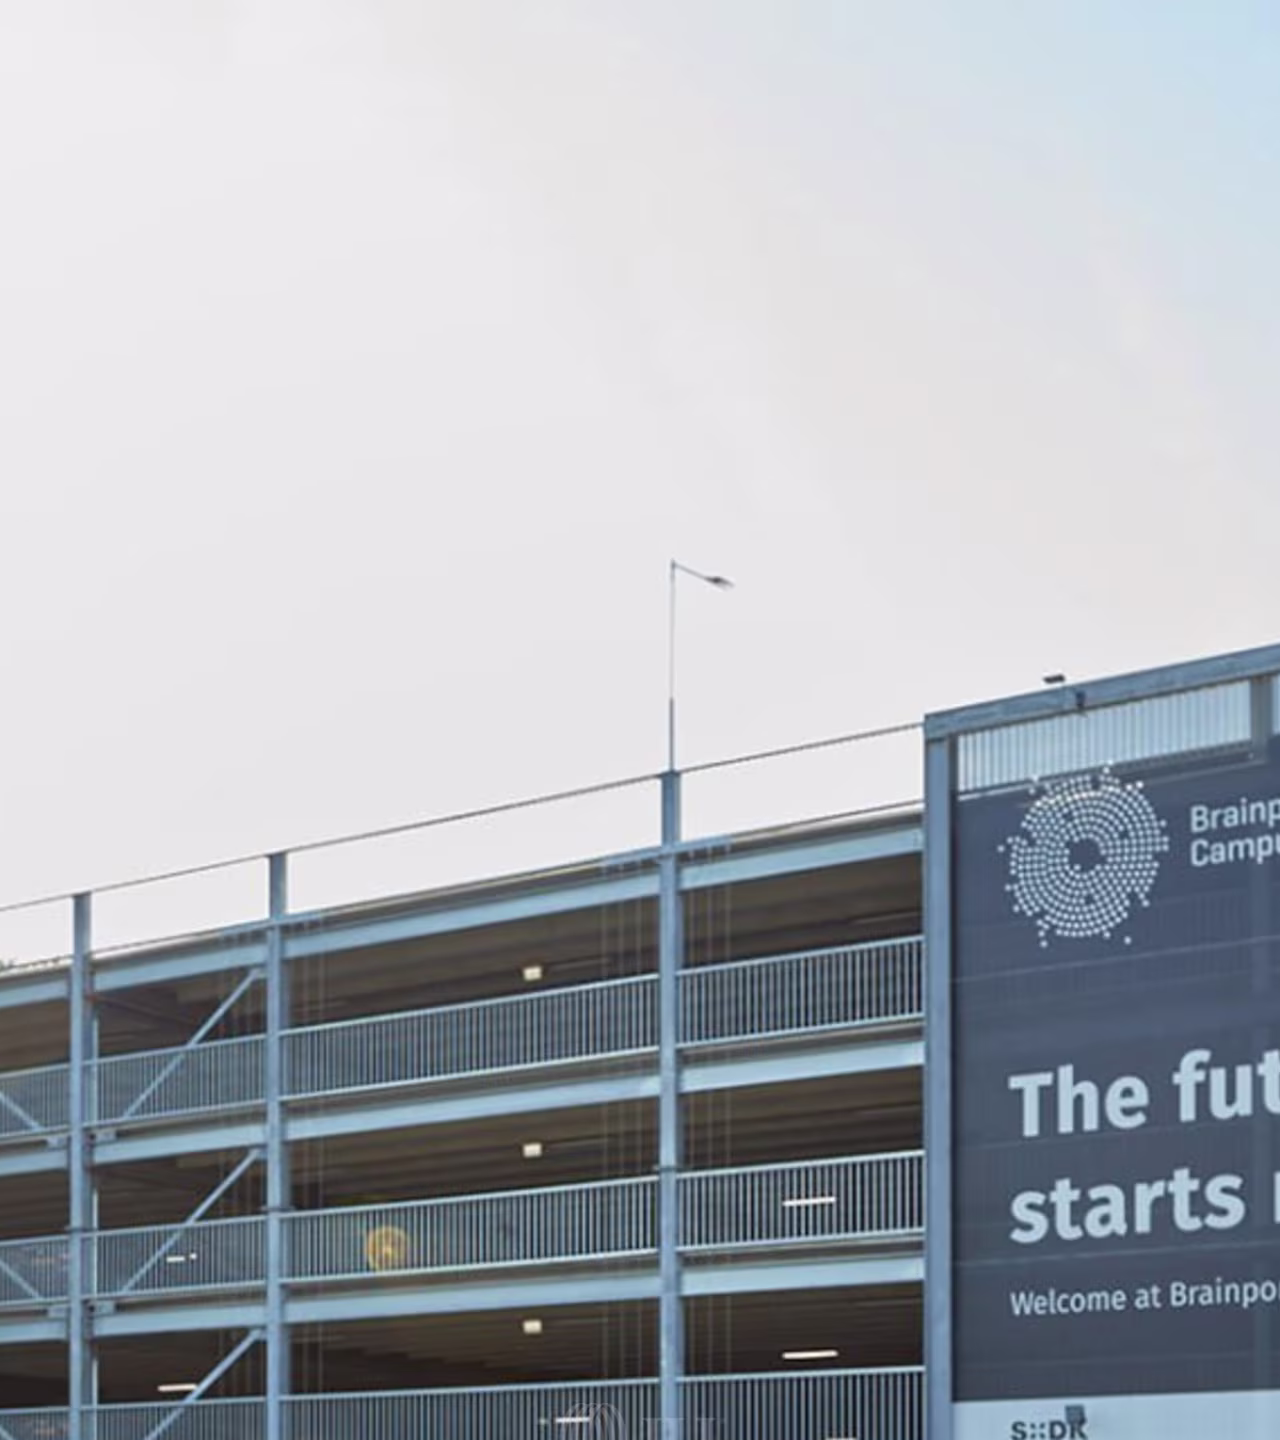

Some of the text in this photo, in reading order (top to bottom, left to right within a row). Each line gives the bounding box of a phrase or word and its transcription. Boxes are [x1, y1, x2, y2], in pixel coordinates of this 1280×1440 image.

[1008, 1064, 1149, 1137] The
[1009, 1167, 1246, 1243] starts
[1010, 1288, 1127, 1316] Welcome
[1134, 1284, 1162, 1309] at
